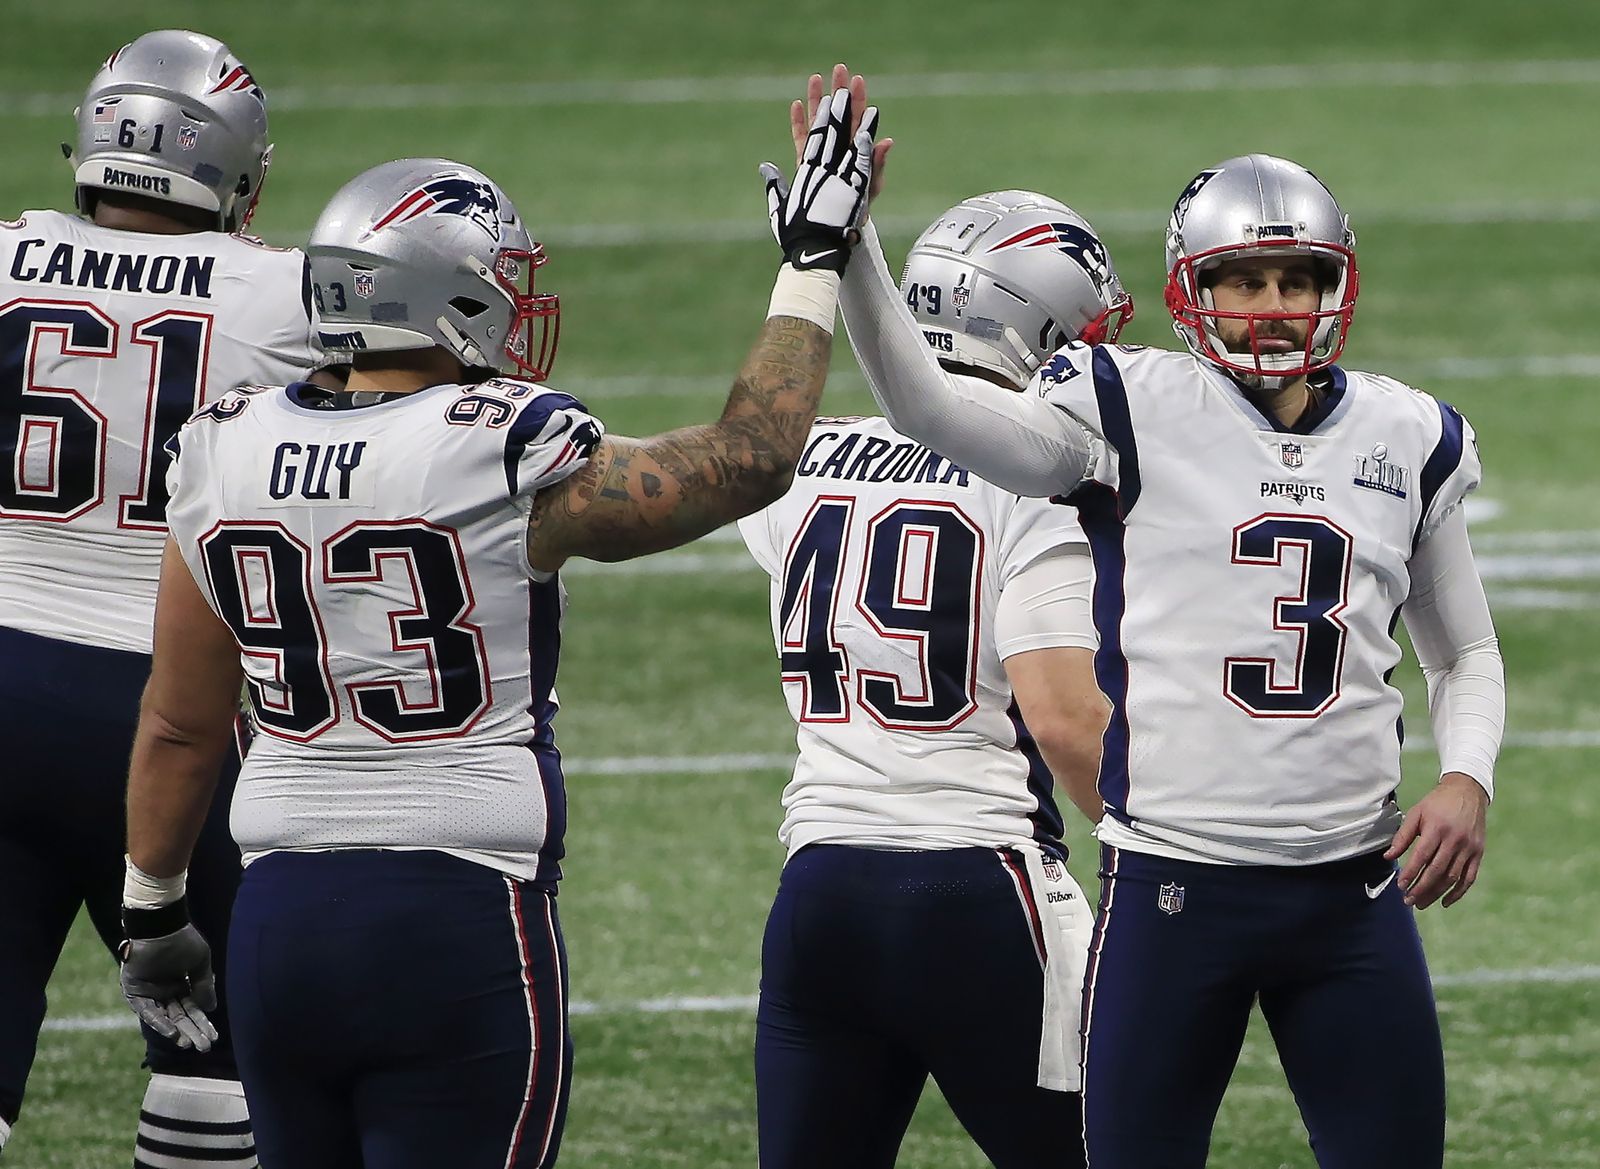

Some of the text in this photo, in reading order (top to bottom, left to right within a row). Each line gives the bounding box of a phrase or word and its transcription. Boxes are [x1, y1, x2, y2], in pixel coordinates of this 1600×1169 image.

[118, 118, 164, 153] 61
[103, 166, 170, 194] PATRIOTS
[10, 238, 216, 299] CANNON
[907, 282, 942, 315] 49
[0, 297, 214, 533] 61
[268, 440, 367, 501] GUY
[1260, 482, 1325, 502] PATRIOTS
[198, 519, 493, 743] 93
[779, 494, 984, 731] 49
[1223, 511, 1354, 718] 3
